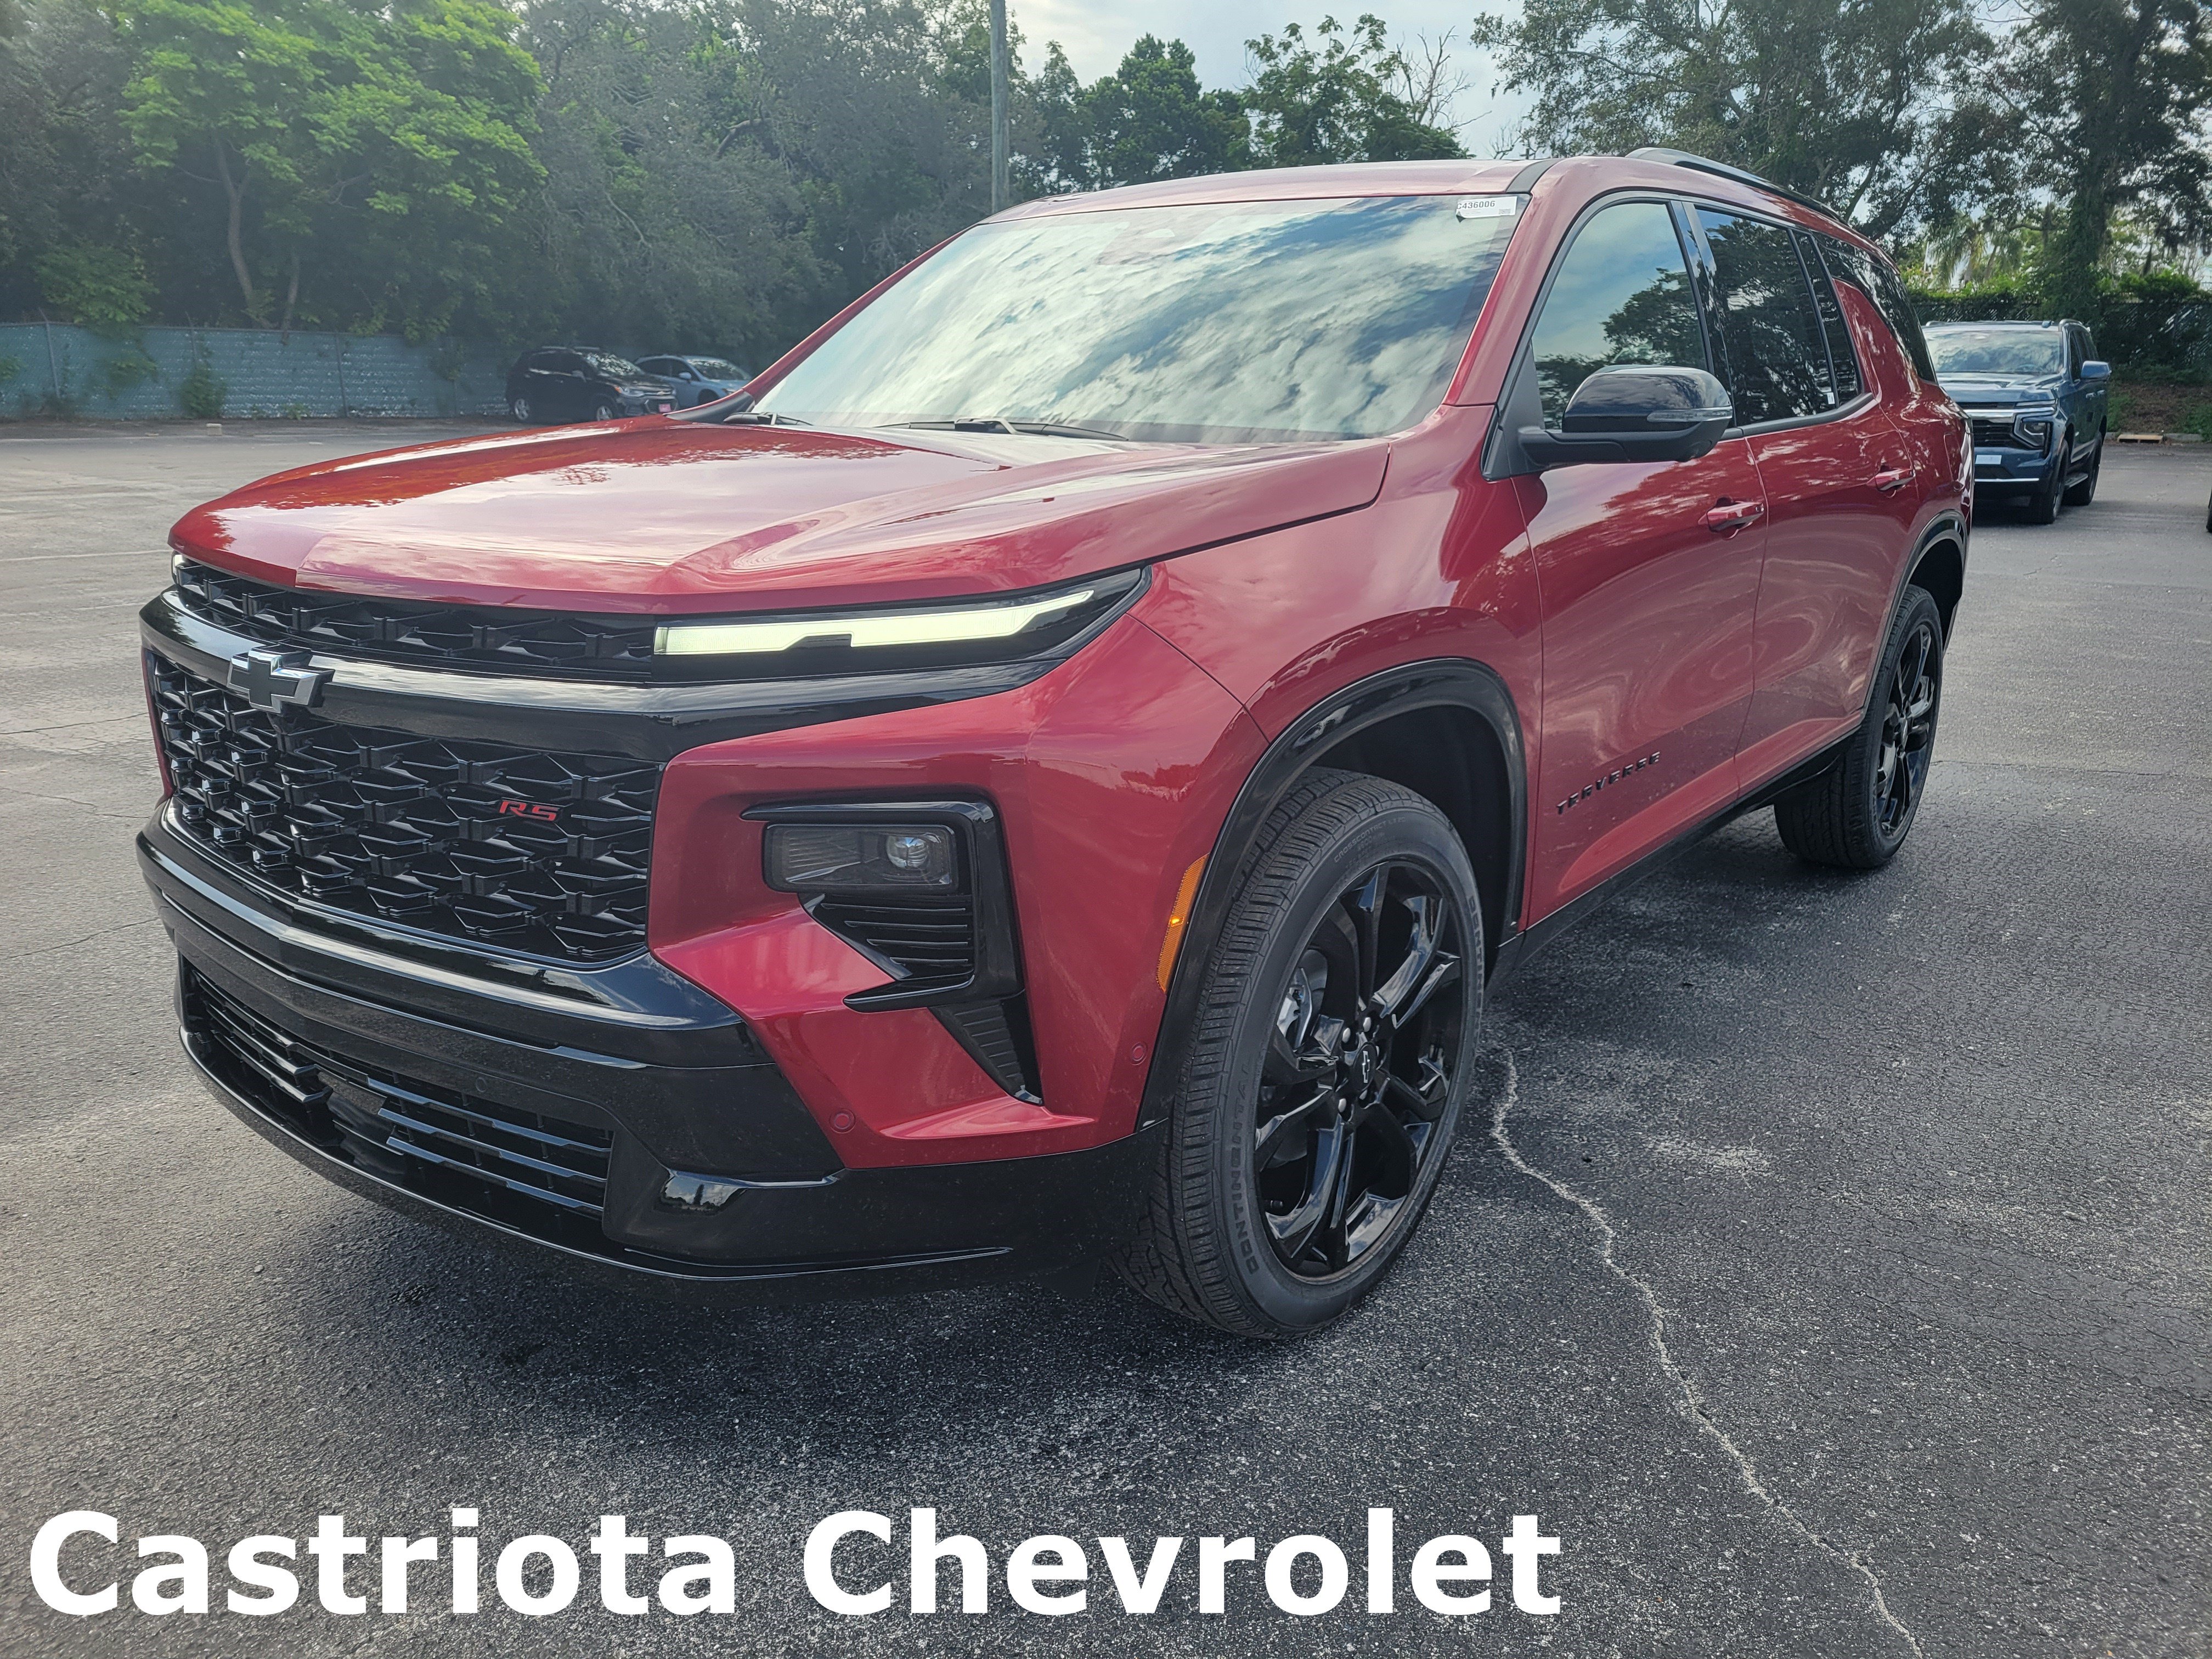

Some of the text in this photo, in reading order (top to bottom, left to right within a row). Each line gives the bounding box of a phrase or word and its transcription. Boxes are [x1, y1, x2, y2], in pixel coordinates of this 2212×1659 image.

[499, 799, 561, 821] RS
[1556, 751, 1661, 815] TRAVERSE
[1231, 1058, 1260, 1275] CONTINENTAL
